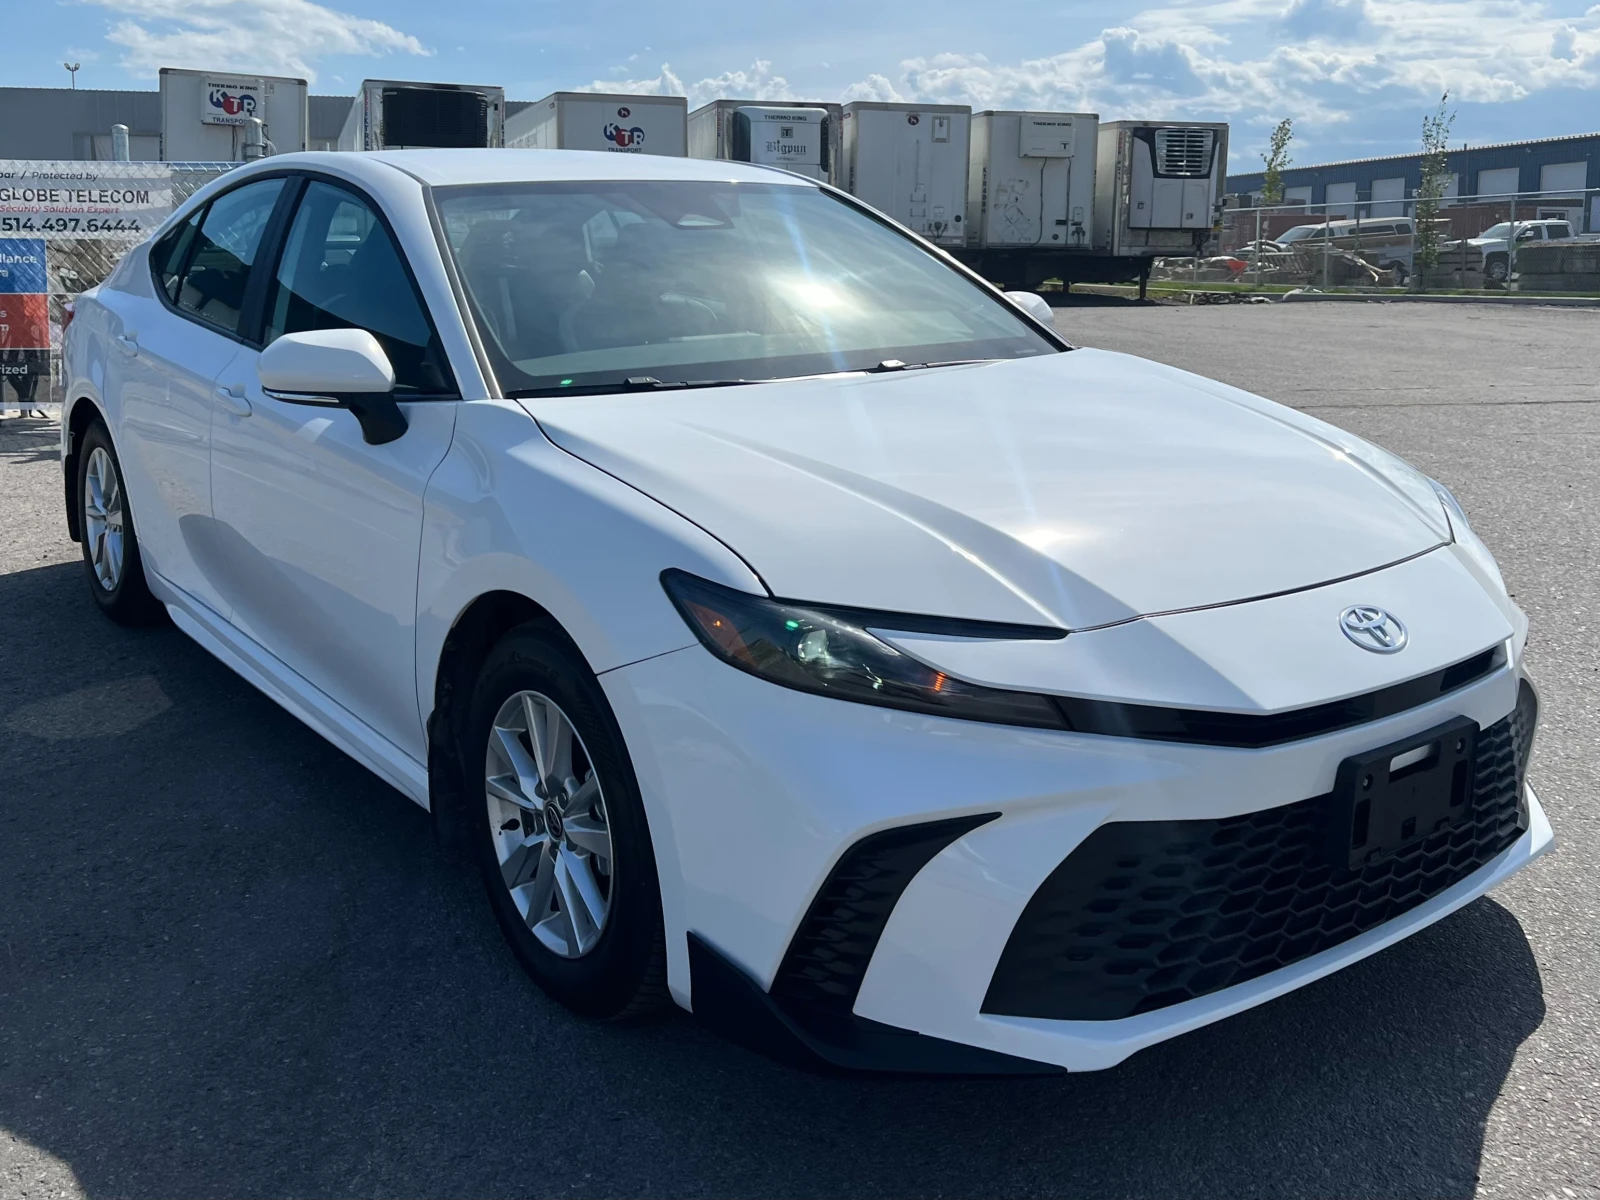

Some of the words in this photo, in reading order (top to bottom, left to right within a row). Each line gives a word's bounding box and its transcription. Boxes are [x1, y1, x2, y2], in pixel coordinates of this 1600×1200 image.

[213, 117, 245, 125] TRANSPO
[604, 122, 645, 146] KTR
[32, 171, 83, 180] Protected
[86, 171, 99, 182] by
[0, 187, 60, 203] GLOBE
[65, 189, 150, 204] TELECOM
[0, 204, 41, 215] Security
[43, 205, 84, 214] Solution
[87, 205, 119, 215] Expert
[2, 217, 141, 233] 514.497.6444
